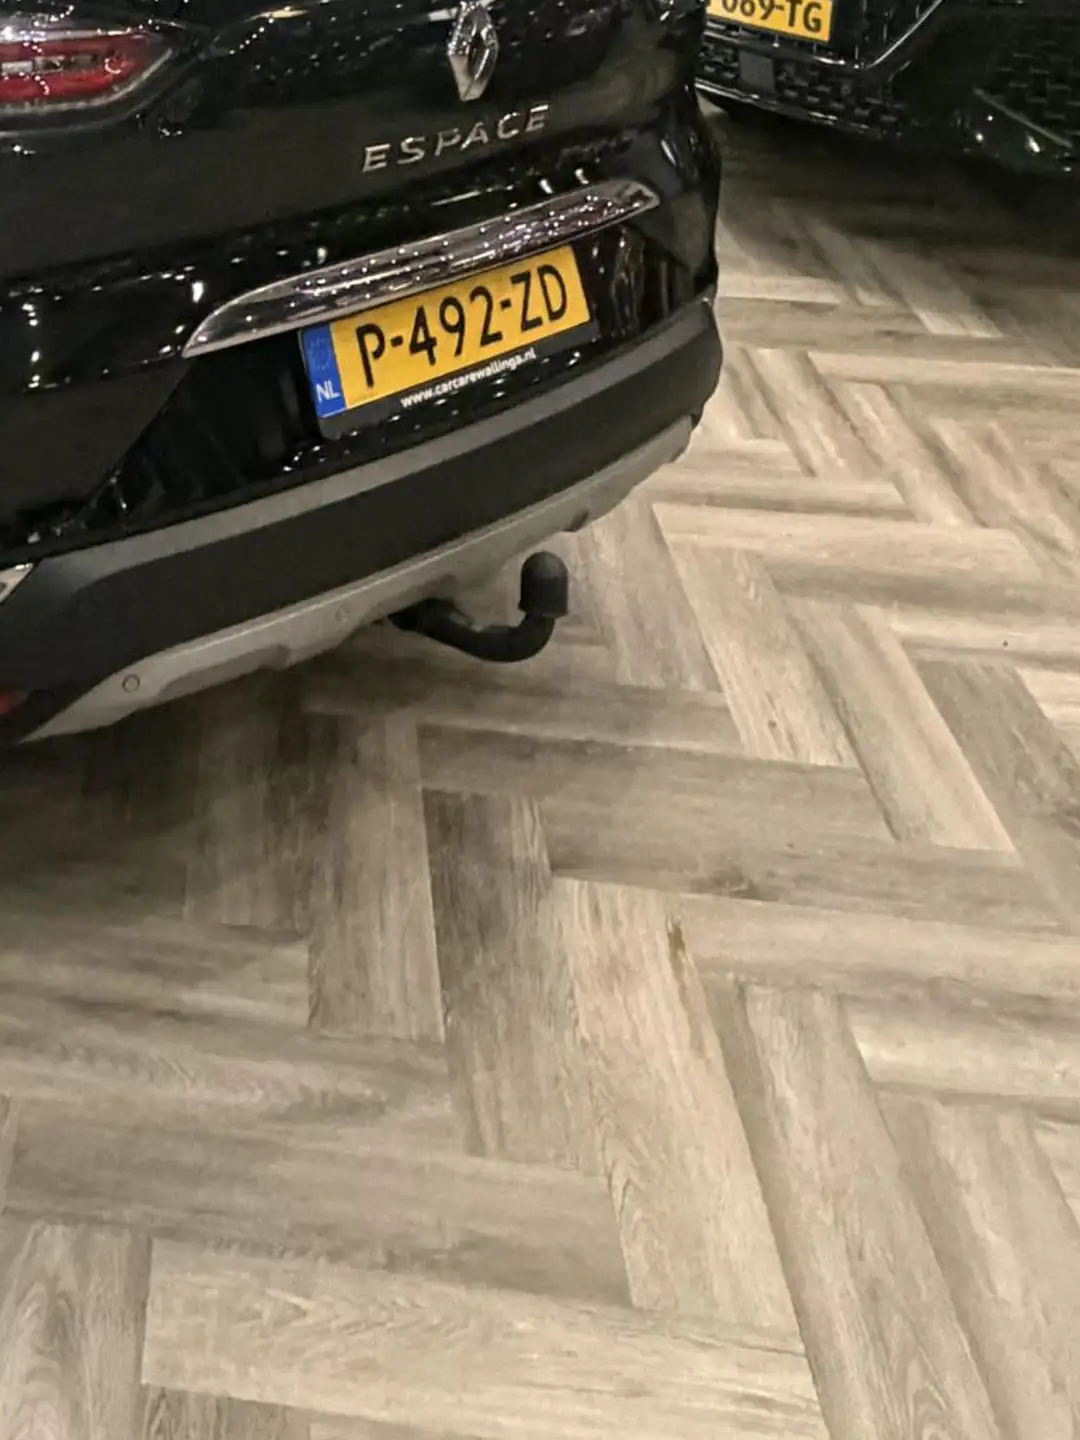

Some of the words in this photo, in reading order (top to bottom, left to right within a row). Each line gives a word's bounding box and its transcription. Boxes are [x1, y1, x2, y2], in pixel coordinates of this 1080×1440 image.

[361, 104, 549, 173] ESPACE
[355, 264, 567, 388] P-492-ZD
[315, 380, 340, 402] NL
